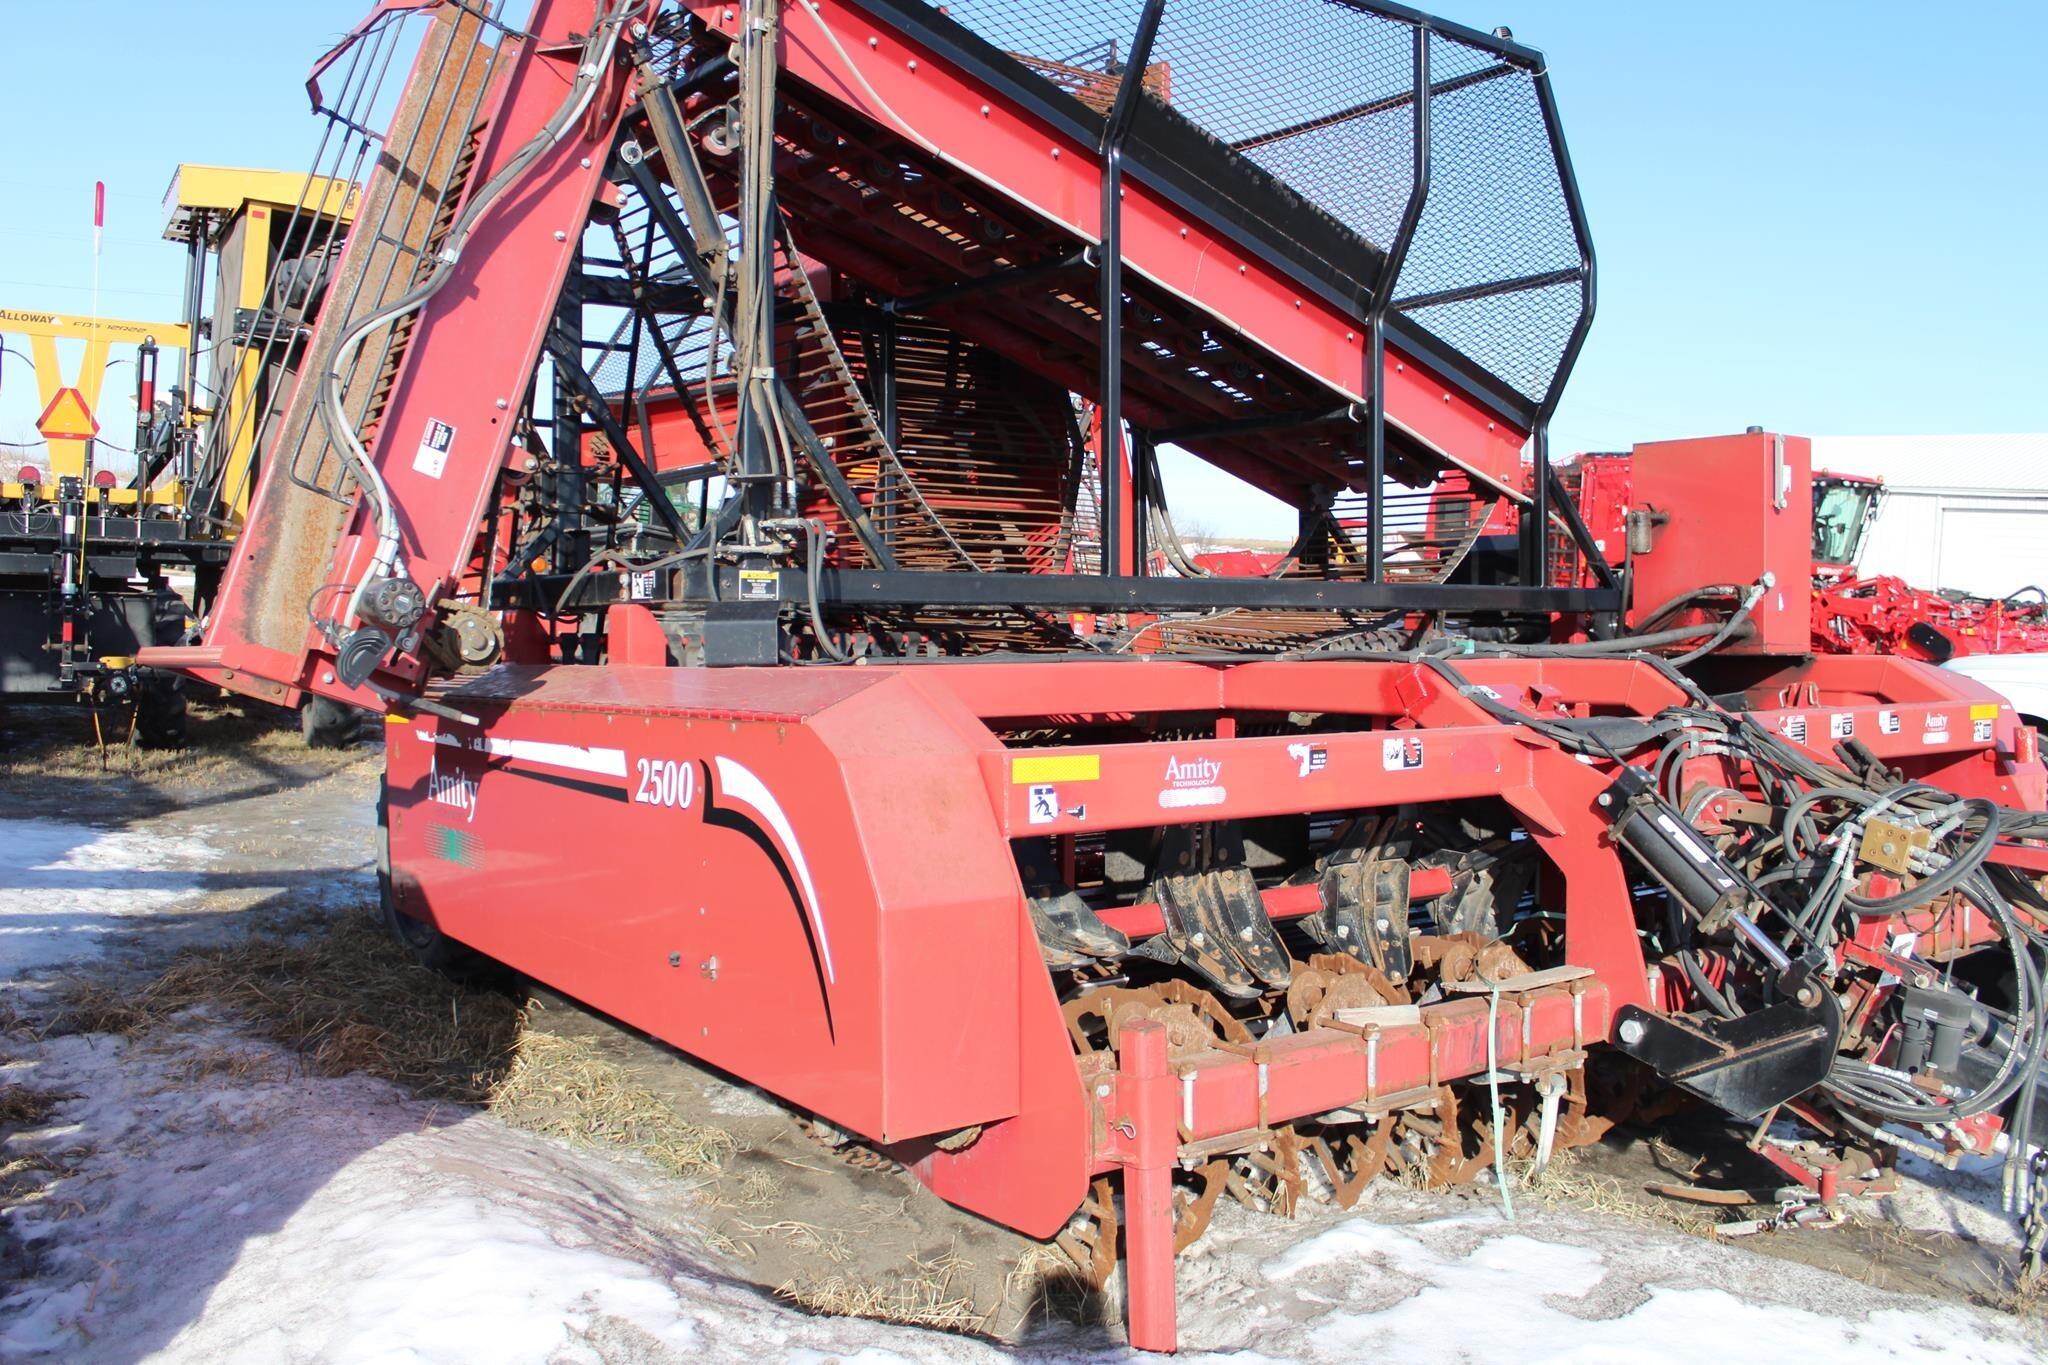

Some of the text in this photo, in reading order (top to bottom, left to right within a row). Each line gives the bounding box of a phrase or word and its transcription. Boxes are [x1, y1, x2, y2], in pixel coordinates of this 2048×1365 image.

[0, 309, 55, 324] ALLOWAY
[1925, 711, 1948, 729] Amity
[1164, 754, 1222, 784] Amity
[427, 754, 479, 823] Amity
[634, 757, 694, 809] 2500
[1172, 779, 1210, 788] TECHNOLOGY
